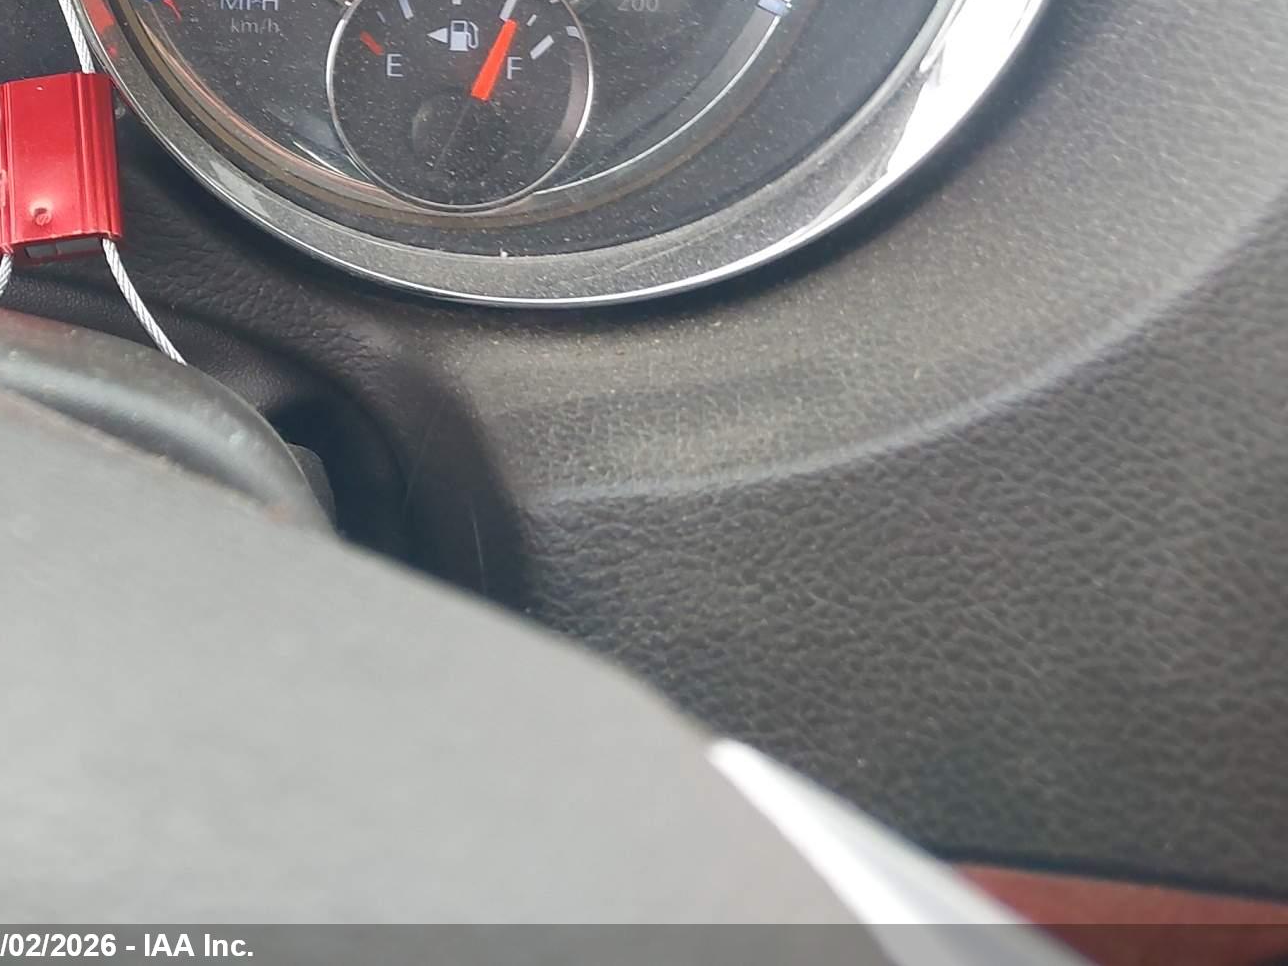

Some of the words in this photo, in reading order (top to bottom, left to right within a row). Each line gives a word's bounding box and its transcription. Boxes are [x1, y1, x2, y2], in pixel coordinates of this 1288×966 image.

[231, 18, 281, 34] km/h
[386, 53, 404, 77] E
[507, 56, 523, 80] F
